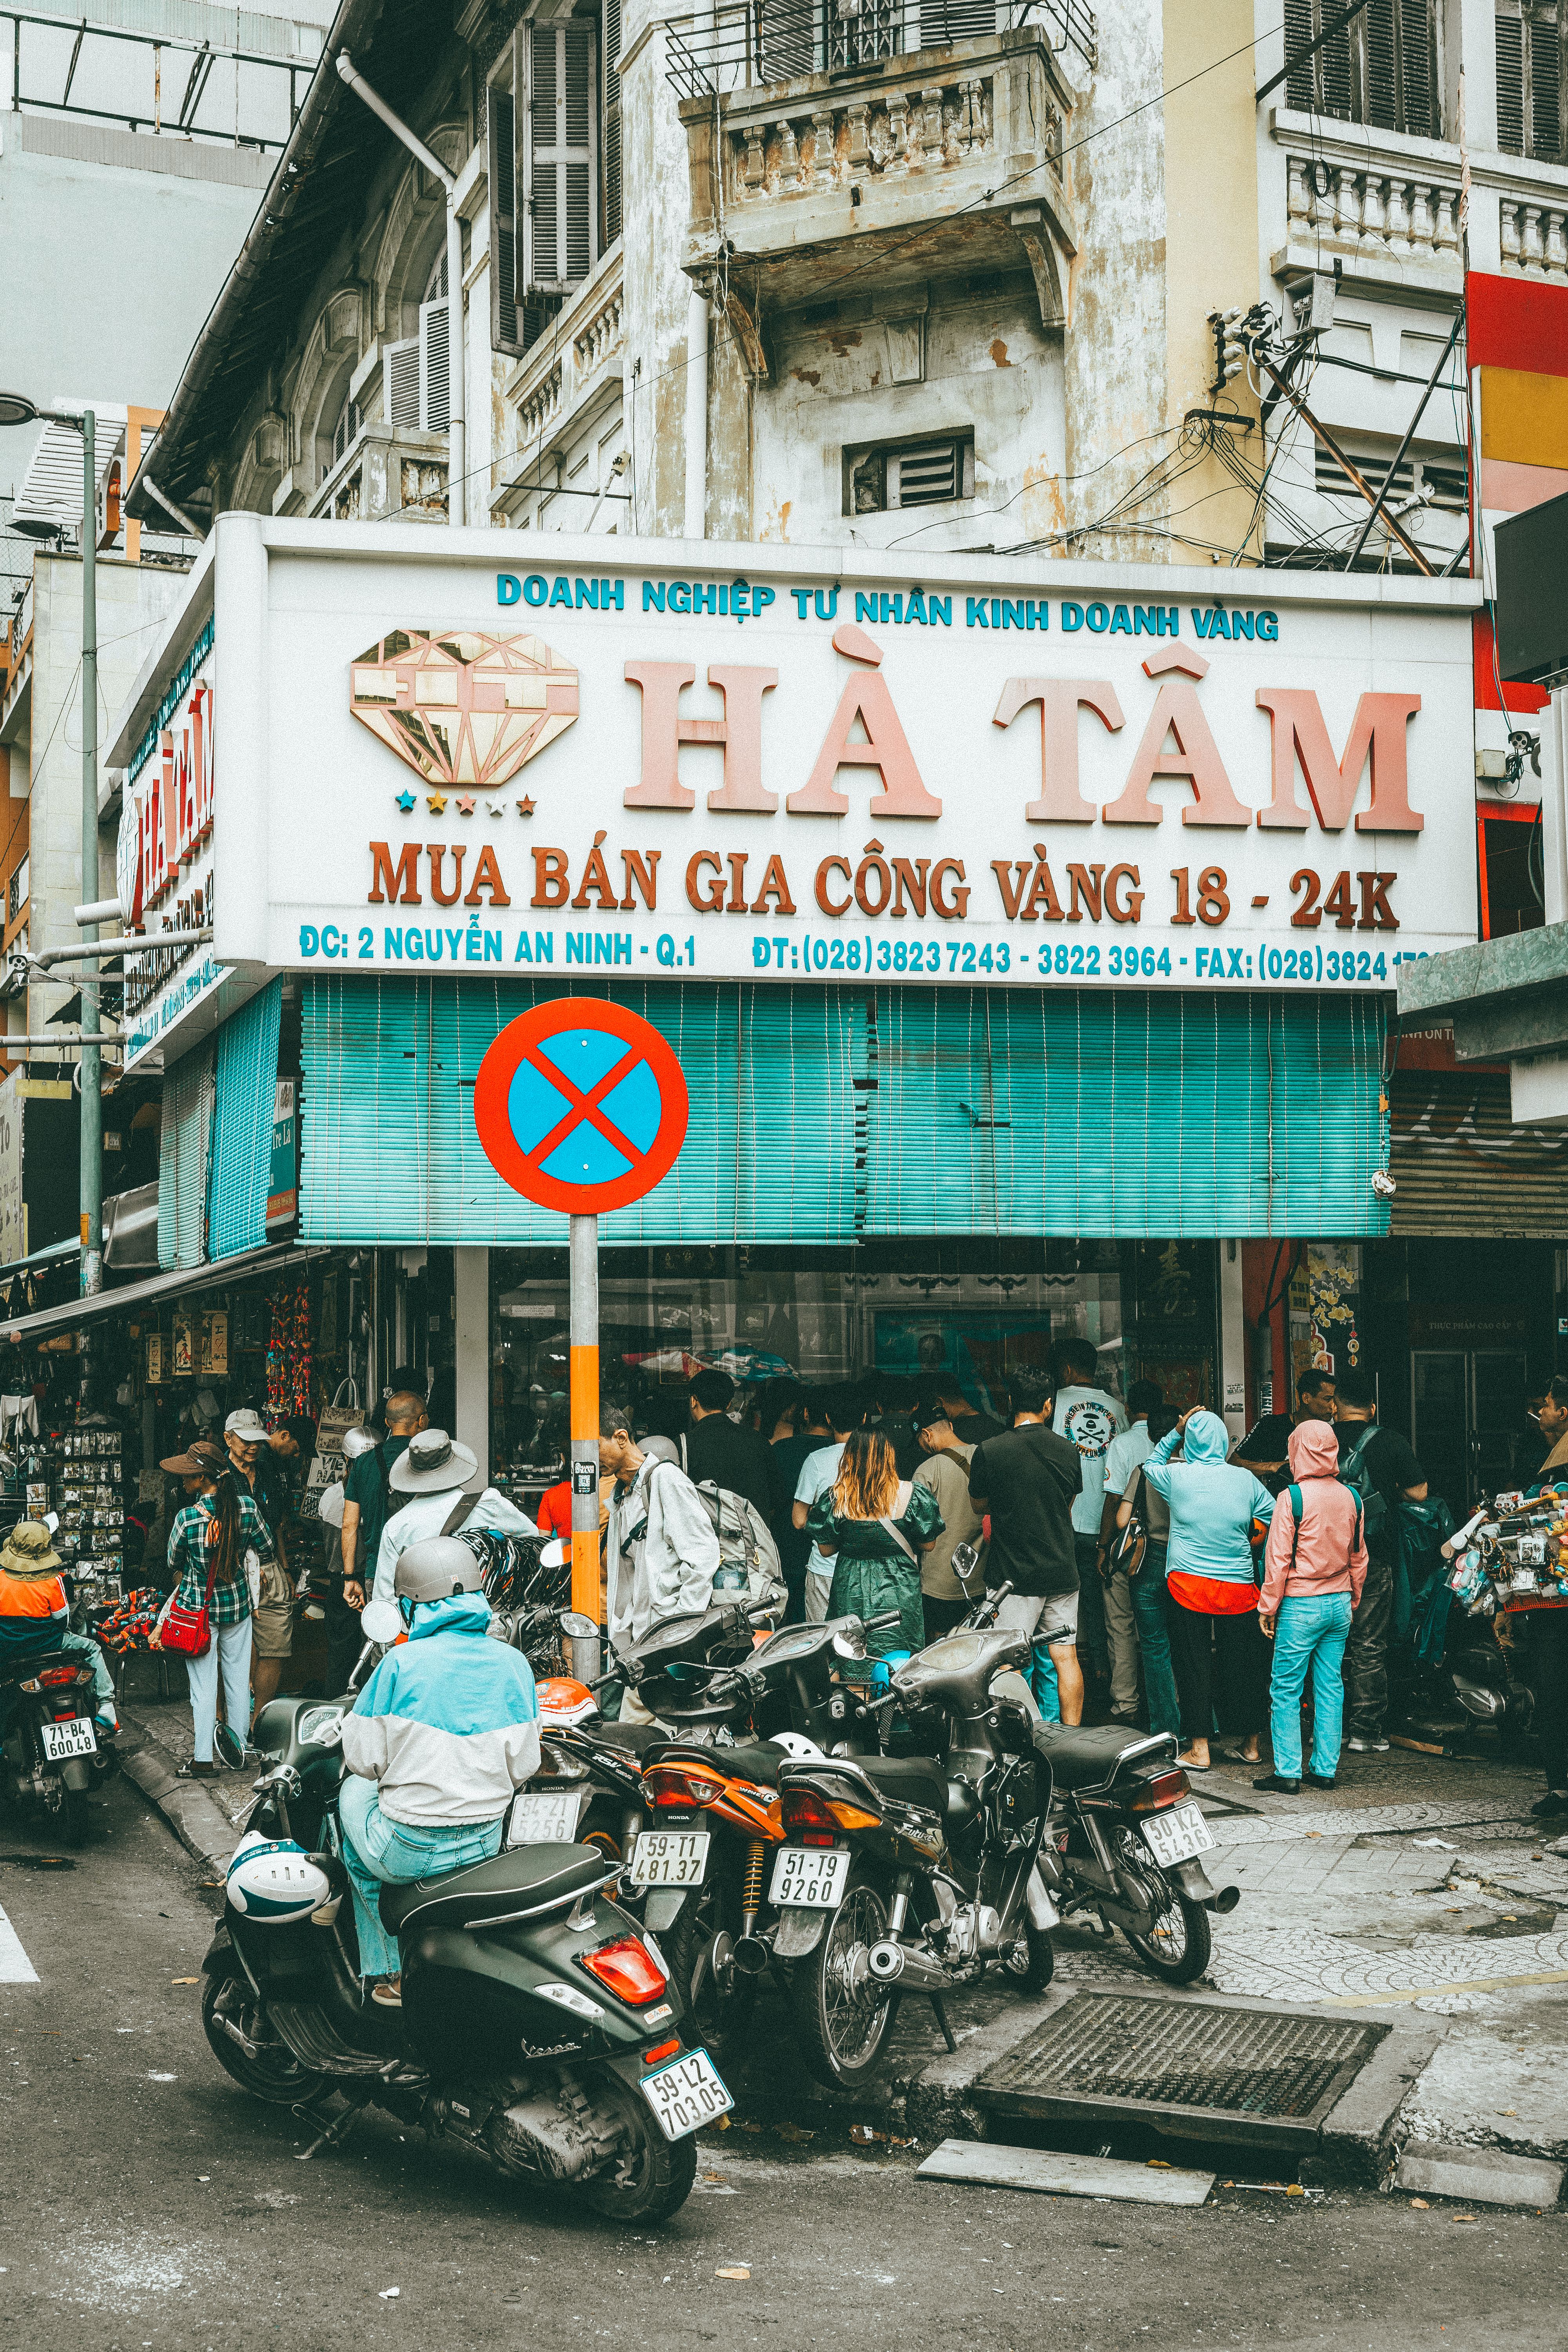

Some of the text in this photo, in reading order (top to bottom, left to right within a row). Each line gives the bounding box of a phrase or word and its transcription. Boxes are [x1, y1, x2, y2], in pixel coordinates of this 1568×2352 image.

[497, 574, 1278, 640] DOANH NGHIỆP TƯ NHÂN KINH DOANH VÀNG
[623, 624, 1424, 832] HÀ TÂM
[368, 842, 511, 906] MUA
[531, 830, 661, 910] BÁN
[686, 851, 796, 915] GIA
[815, 839, 970, 919] CÔNG
[991, 844, 1145, 923] VÀNG
[1171, 866, 1230, 926] 18
[1290, 869, 1399, 931] 24K
[299, 925, 348, 957] ĐC:
[358, 927, 374, 958] 2
[385, 914, 502, 961] NGUYỄN
[515, 931, 553, 962] AN
[566, 932, 632, 964] NINH
[656, 933, 695, 967] Q.1
[1038, 944, 1100, 975] 3822
[1109, 946, 1172, 976] 3964
[49, 1721, 86, 1743] 71-B4
[50, 1737, 92, 1756] 600.48
[1149, 1808, 1200, 1841] 50-K2
[647, 1836, 695, 1858] 59-T1
[1158, 1828, 1208, 1861] 5436
[636, 1859, 700, 1882] 481.37
[786, 1854, 838, 1877] 51-T9
[780, 1878, 833, 1902] 9260
[521, 2038, 581, 2059] Vespa
[653, 2058, 708, 2103] 59-L2
[661, 2081, 727, 2135] 703.05
